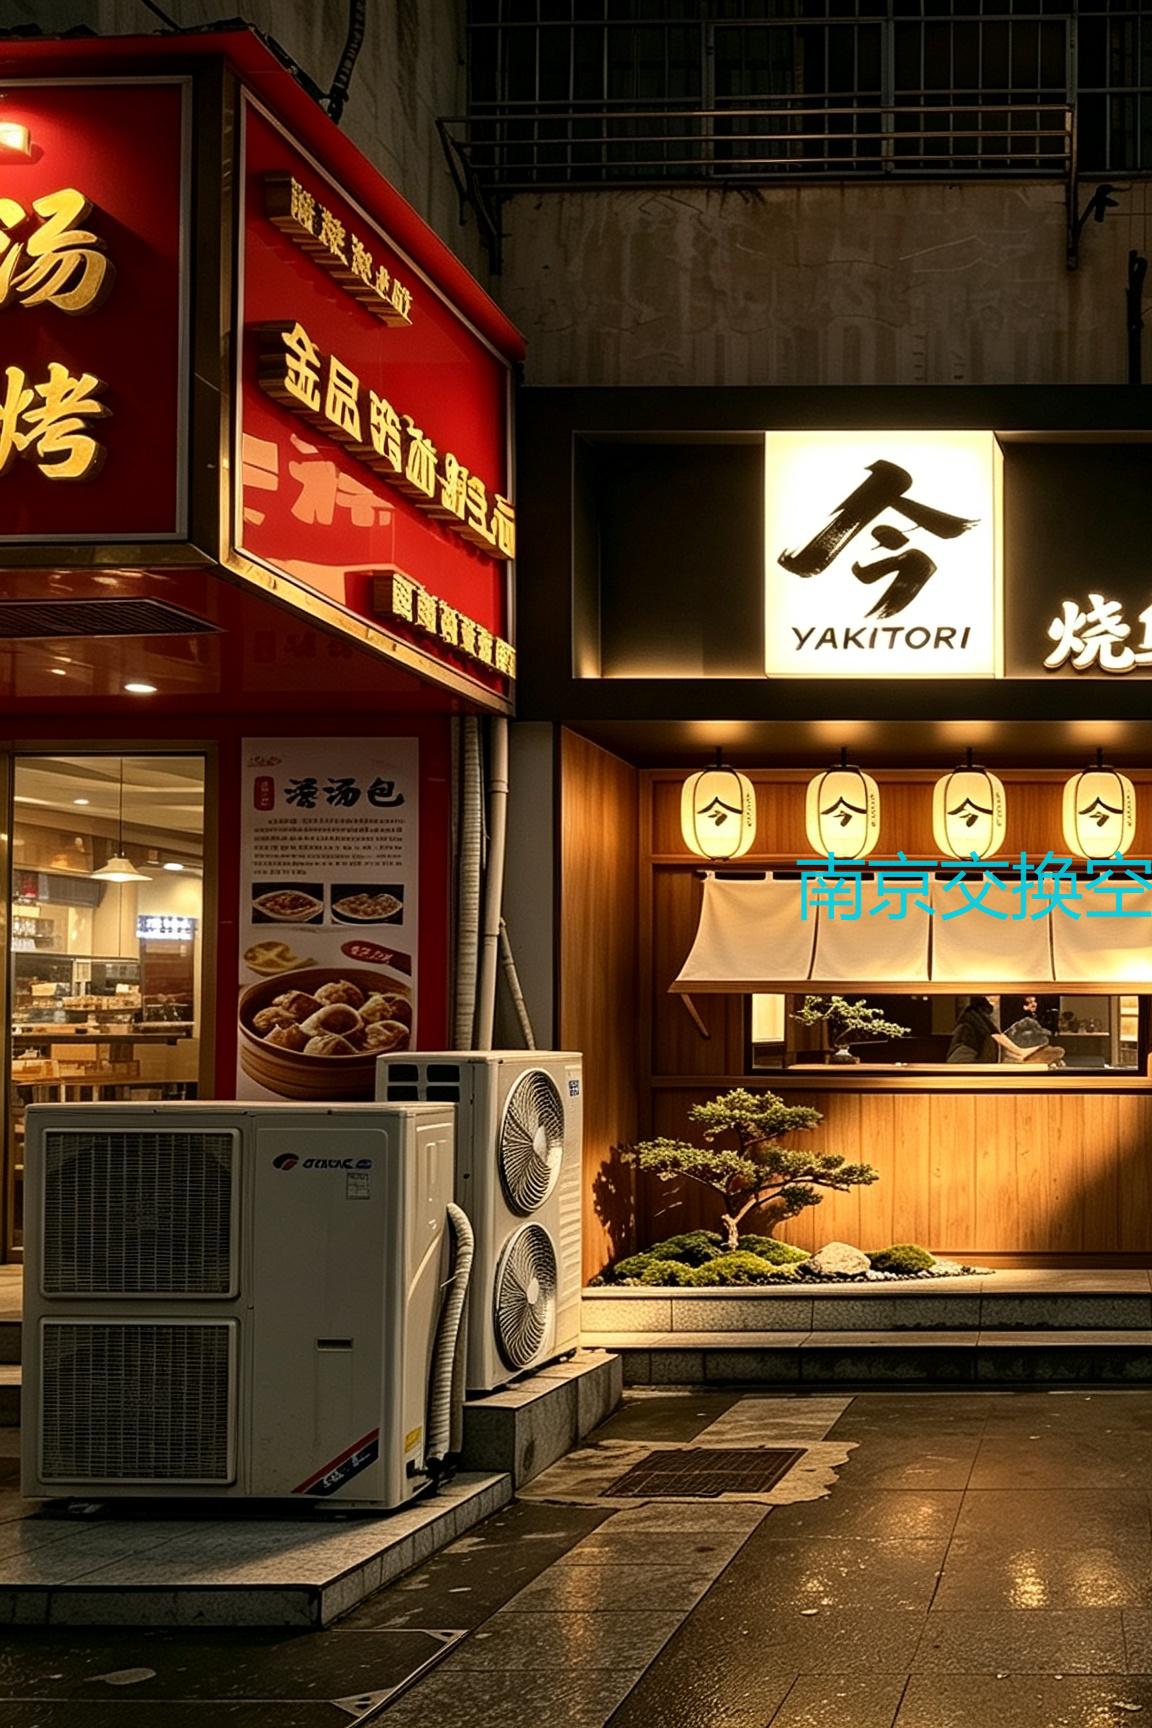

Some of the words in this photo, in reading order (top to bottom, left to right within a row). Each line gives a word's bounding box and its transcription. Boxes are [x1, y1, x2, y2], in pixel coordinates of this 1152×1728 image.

[0, 187, 108, 311] 汤
[0, 362, 102, 477] 烤
[777, 459, 981, 619] 今
[792, 626, 971, 651] YAKITORI
